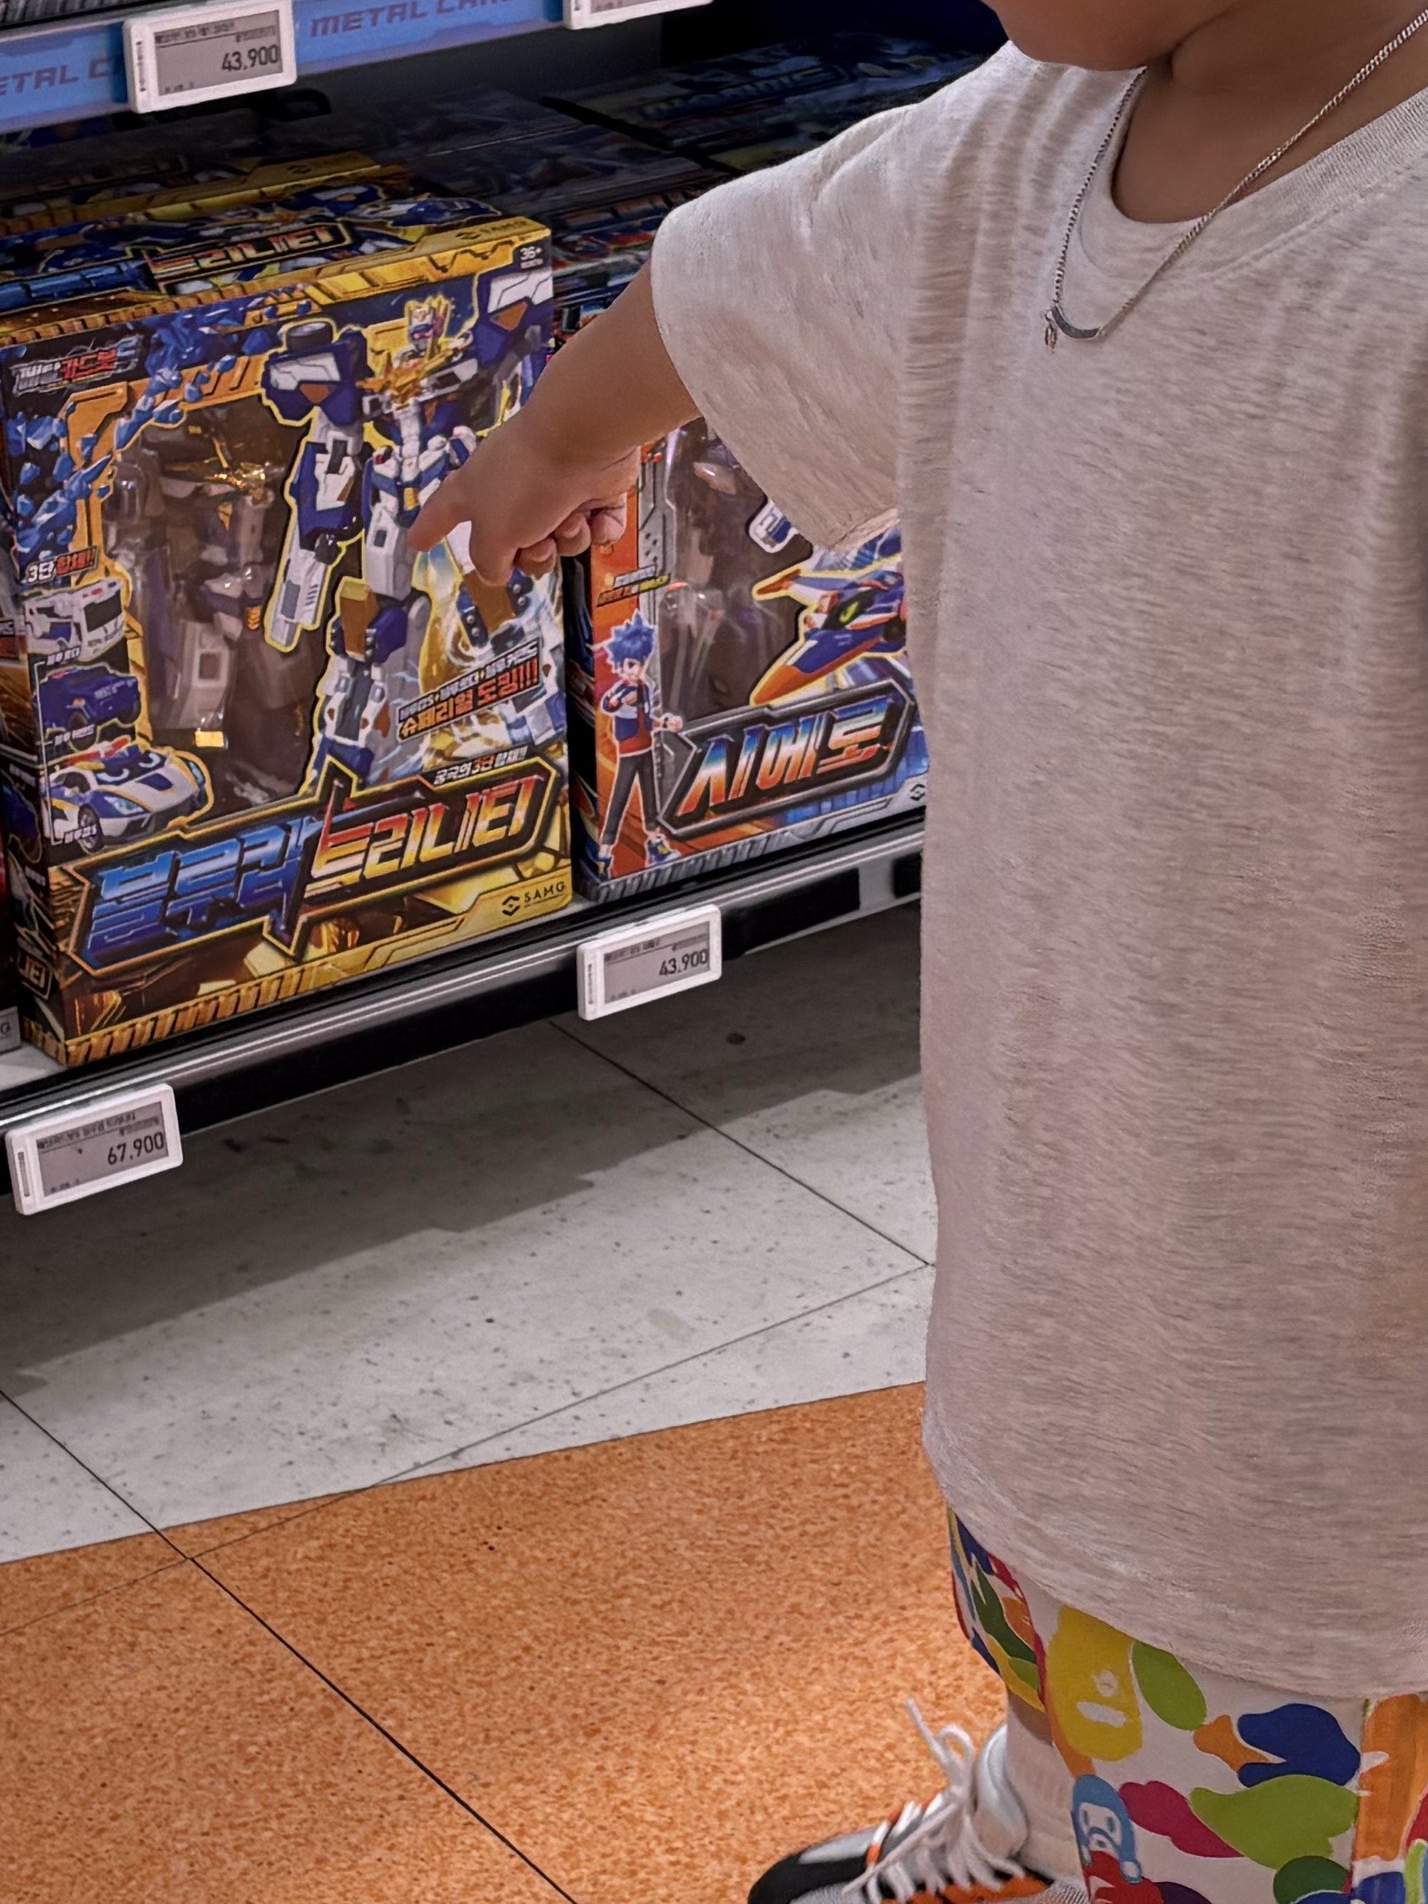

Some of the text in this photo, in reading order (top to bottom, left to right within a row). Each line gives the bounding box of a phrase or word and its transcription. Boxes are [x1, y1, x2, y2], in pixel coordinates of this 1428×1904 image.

[520, 246, 542, 261] 36+
[676, 695, 894, 817] 시에로
[87, 773, 548, 966] 블루캅 트리니티
[523, 880, 567, 905] SAMG
